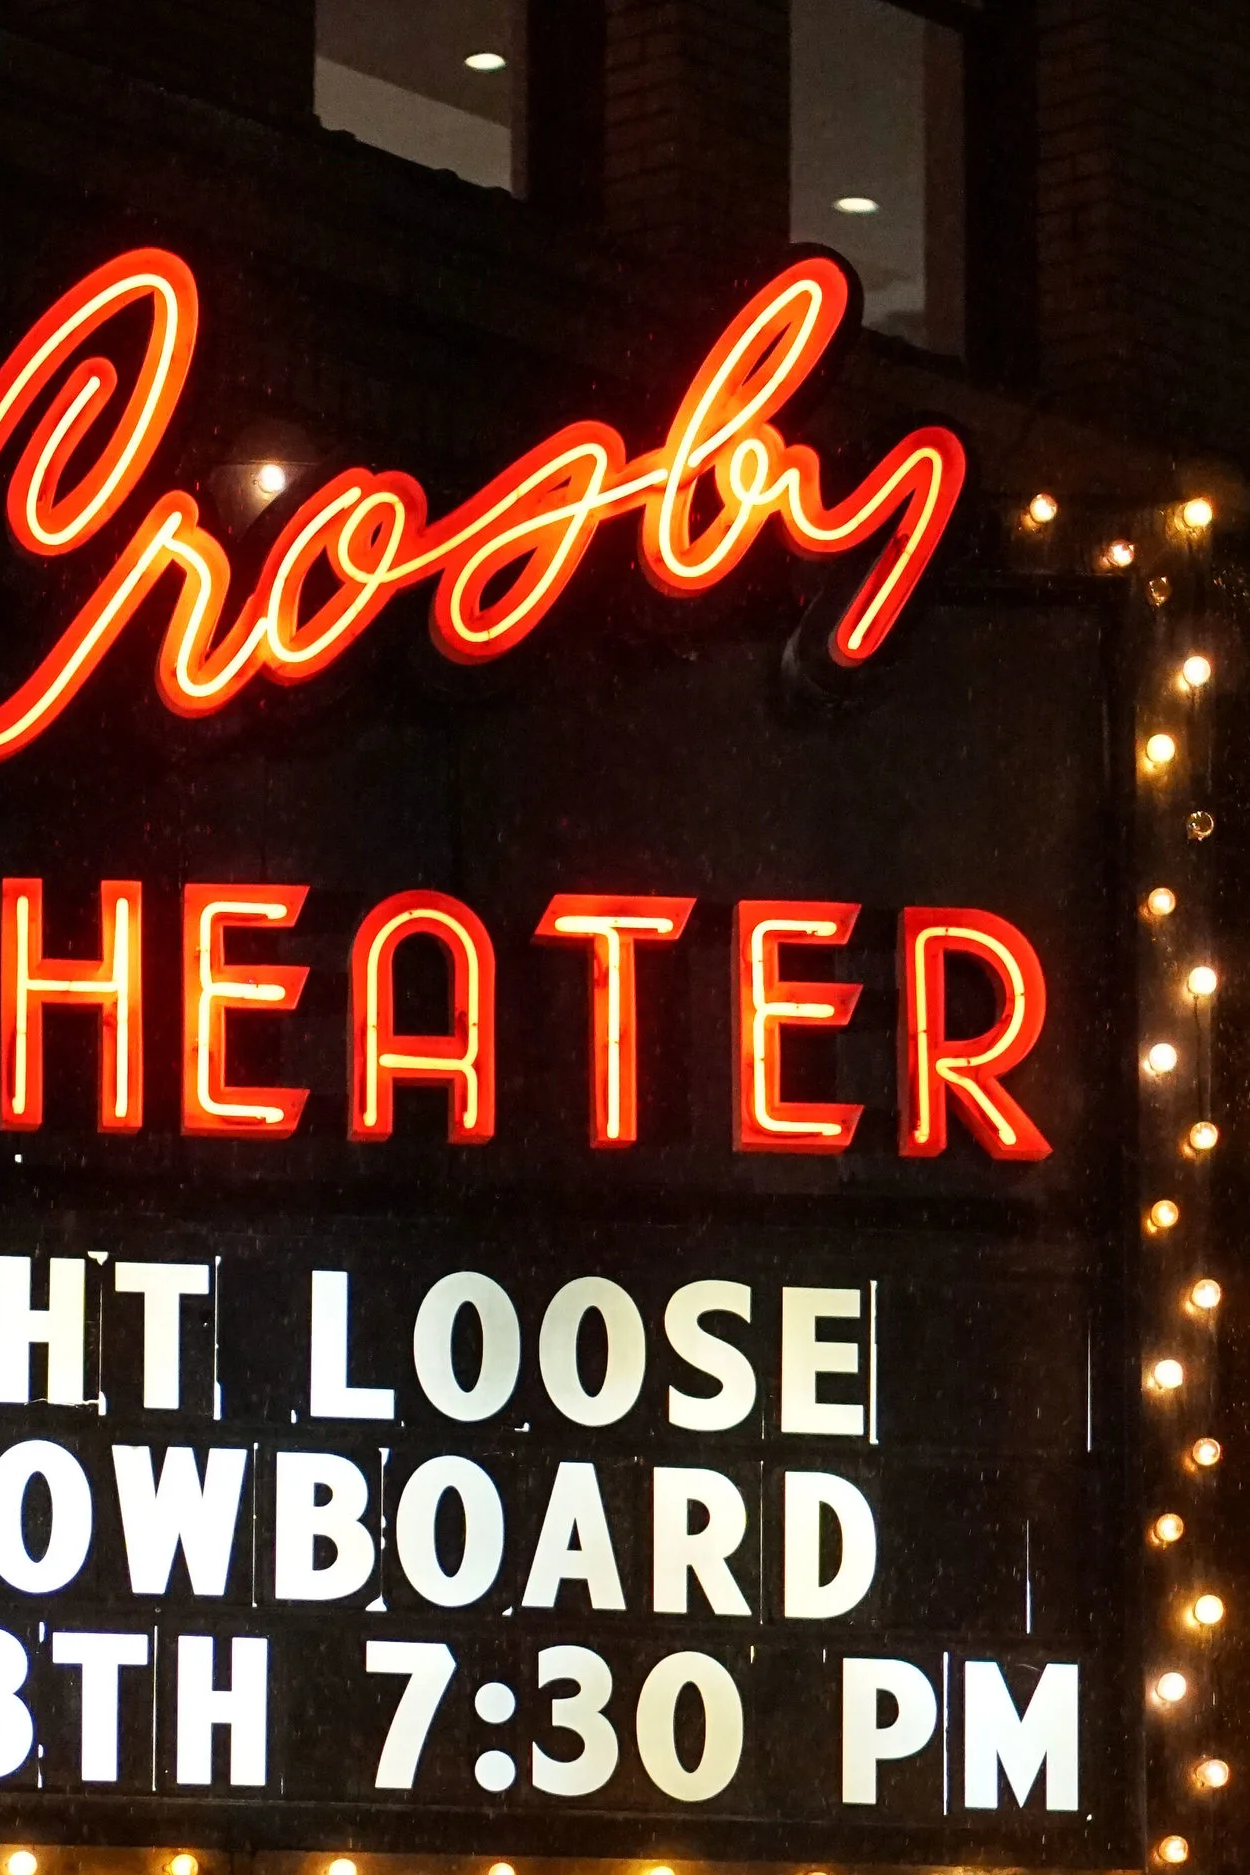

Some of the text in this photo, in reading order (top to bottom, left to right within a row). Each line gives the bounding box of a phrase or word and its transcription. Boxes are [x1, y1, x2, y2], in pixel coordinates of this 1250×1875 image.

[310, 1269, 866, 1435] LOOSE
[364, 1640, 745, 1802] 7:30
[841, 1657, 1079, 1812] PM
